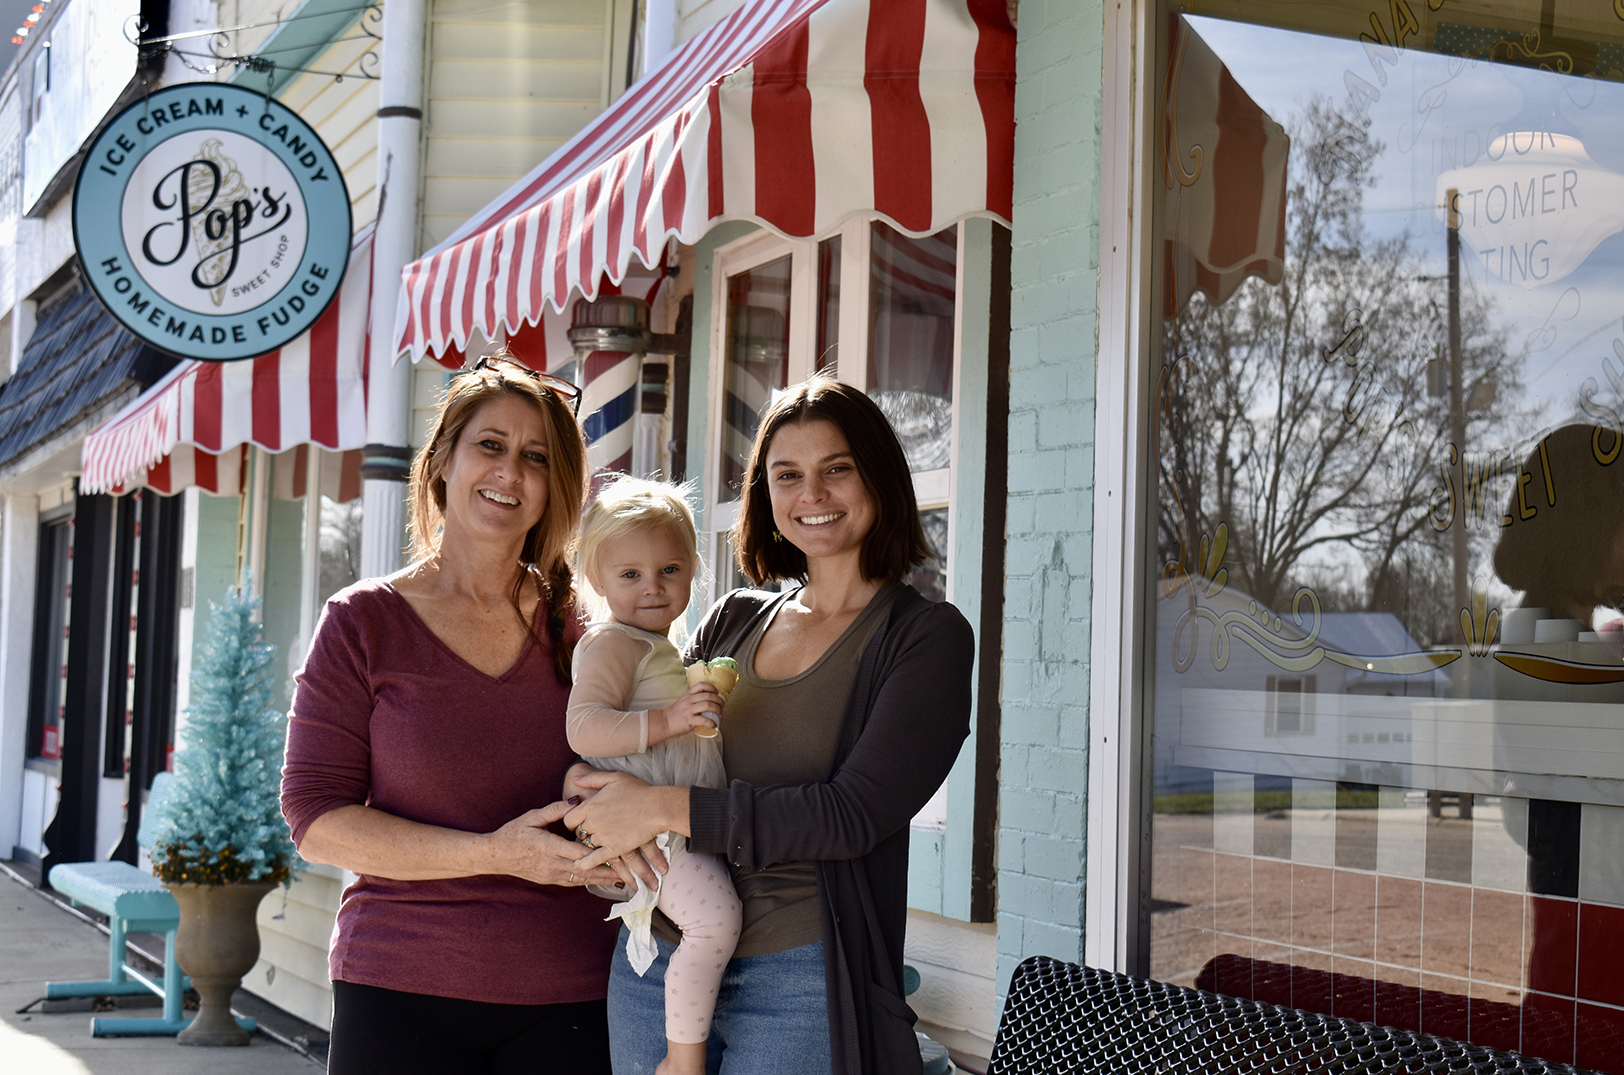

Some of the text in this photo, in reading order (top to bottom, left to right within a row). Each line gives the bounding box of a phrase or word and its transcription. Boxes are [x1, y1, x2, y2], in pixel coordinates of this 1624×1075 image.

[100, 98, 329, 182] ICE CREAM + CANDY
[142, 159, 292, 290] Pop's
[232, 234, 289, 298] SWEET SHOP
[101, 256, 330, 345] HOMEMADE FUDGE
[1429, 427, 1556, 532] SWEET
